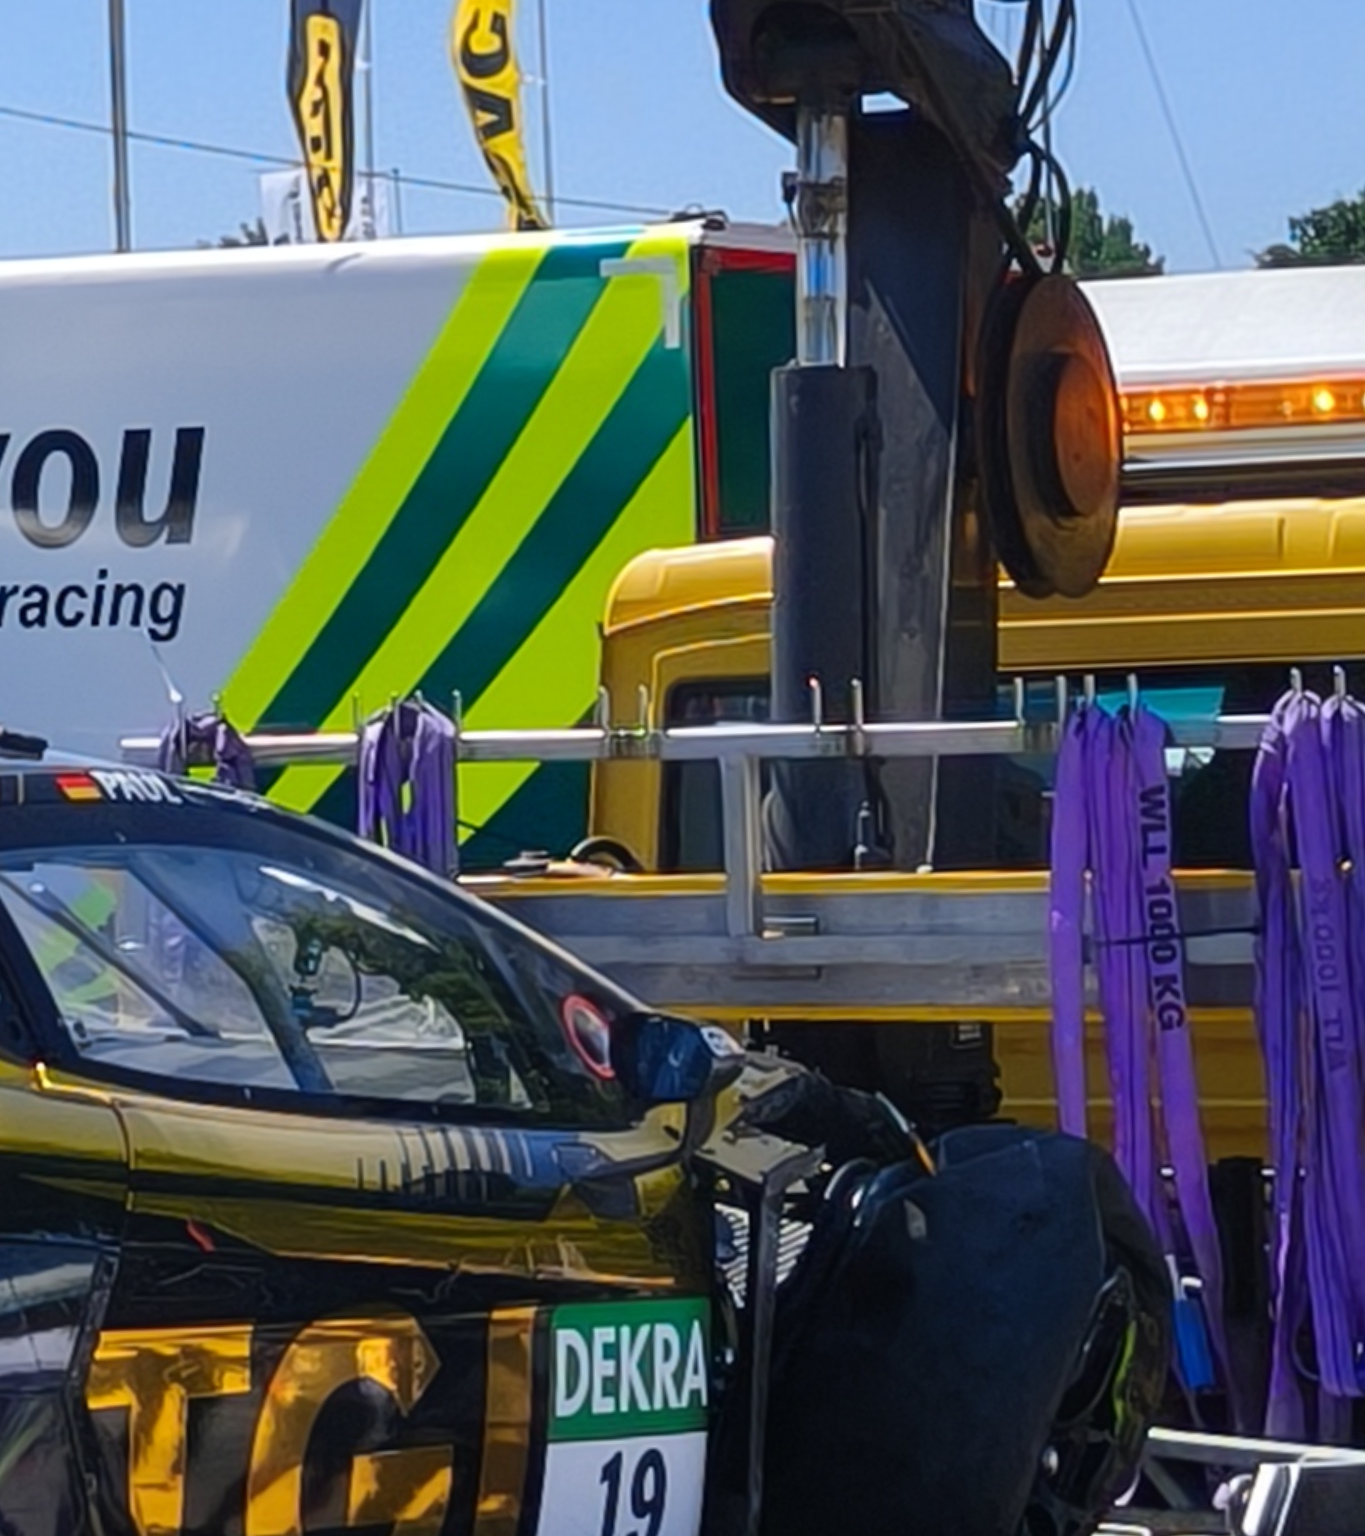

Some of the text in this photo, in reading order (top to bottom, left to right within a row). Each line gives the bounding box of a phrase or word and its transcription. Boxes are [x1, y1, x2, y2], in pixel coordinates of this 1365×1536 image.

[89, 769, 183, 804] PAUL
[1139, 784, 1186, 1031] WLL 1000 KG
[555, 1319, 709, 1418] DEKRA
